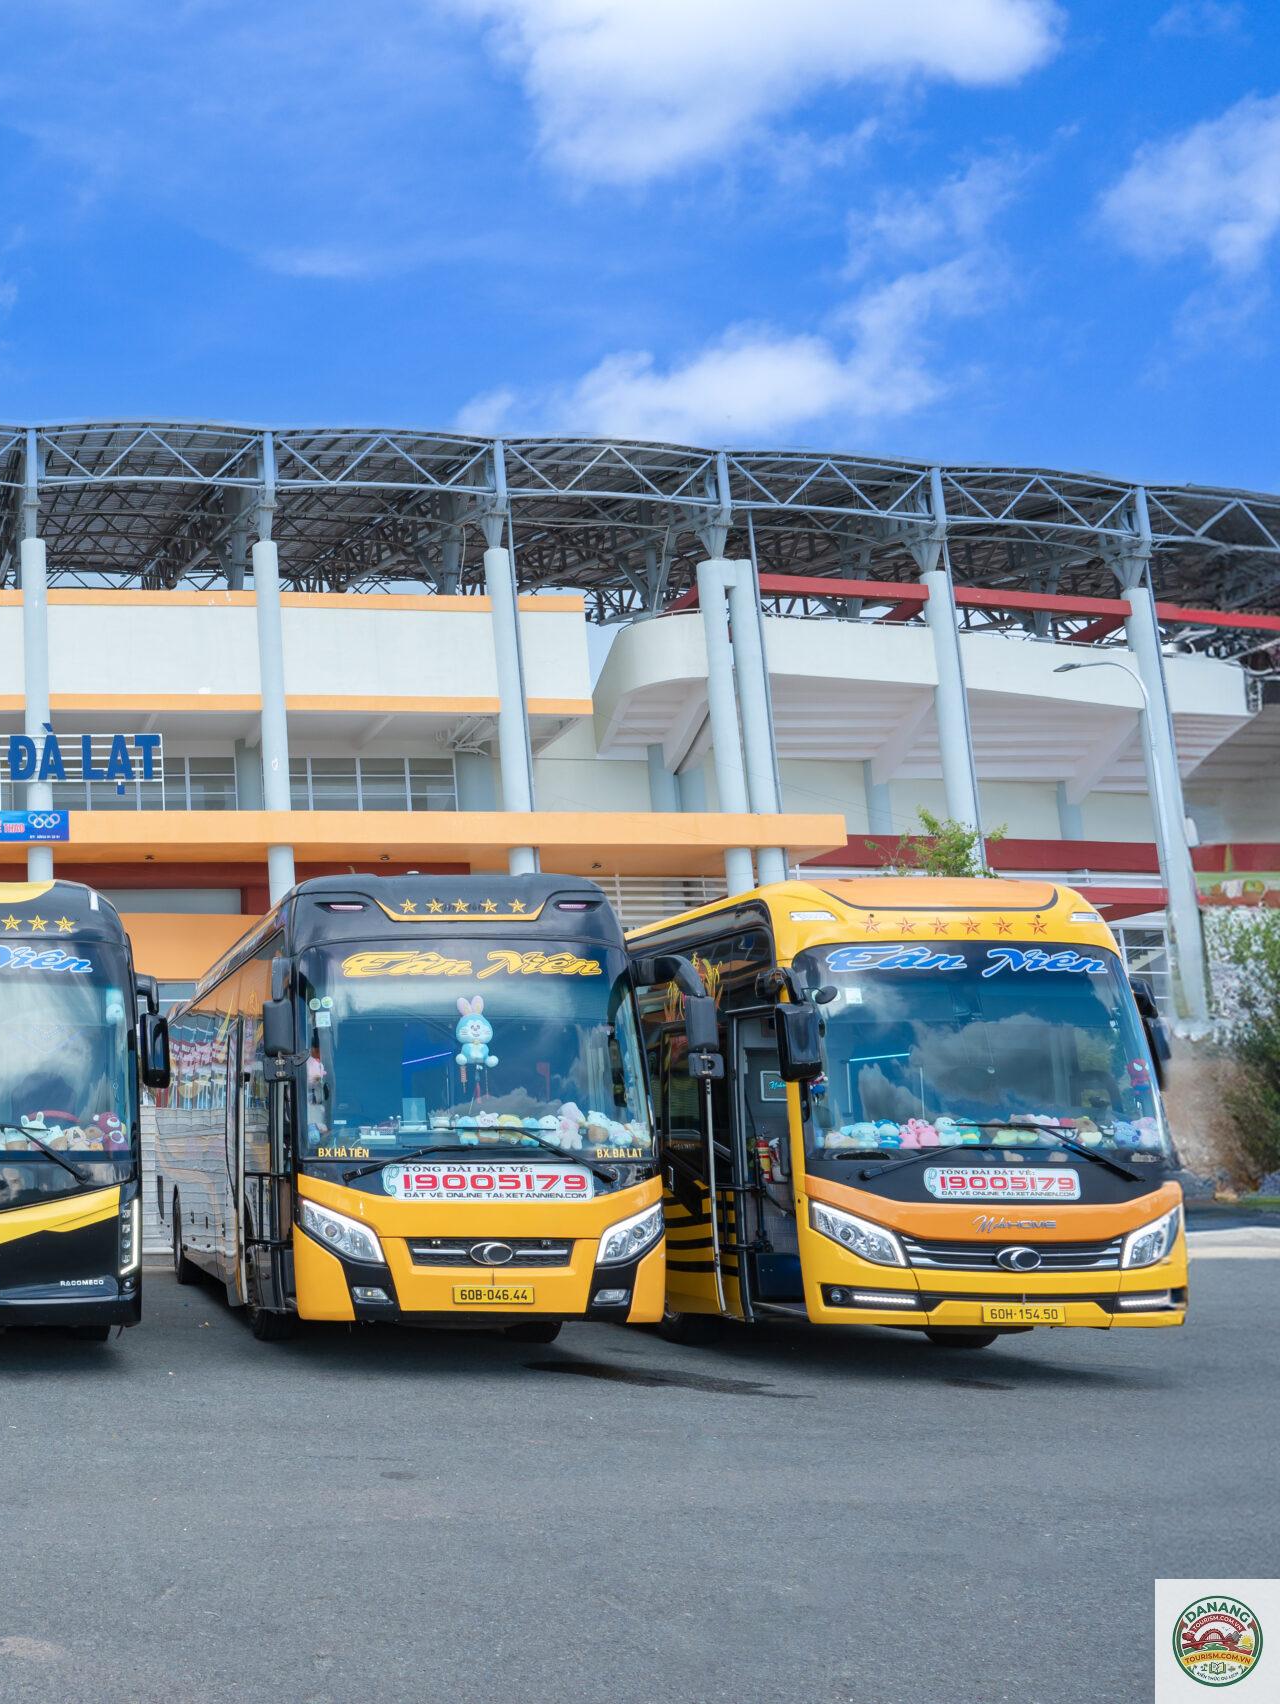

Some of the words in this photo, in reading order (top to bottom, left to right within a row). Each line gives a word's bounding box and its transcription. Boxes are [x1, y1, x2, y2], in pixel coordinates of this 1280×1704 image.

[7, 722, 67, 781] ĐÀ
[81, 734, 161, 796] LẠT
[4, 823, 25, 833] THAO
[447, 1165, 471, 1173] ĐÀI
[403, 1174, 587, 1190] 19005179
[939, 1176, 1076, 1191] 19005179
[460, 1289, 528, 1301] 60B-046.44
[990, 1308, 1058, 1320] 60H-154.50
